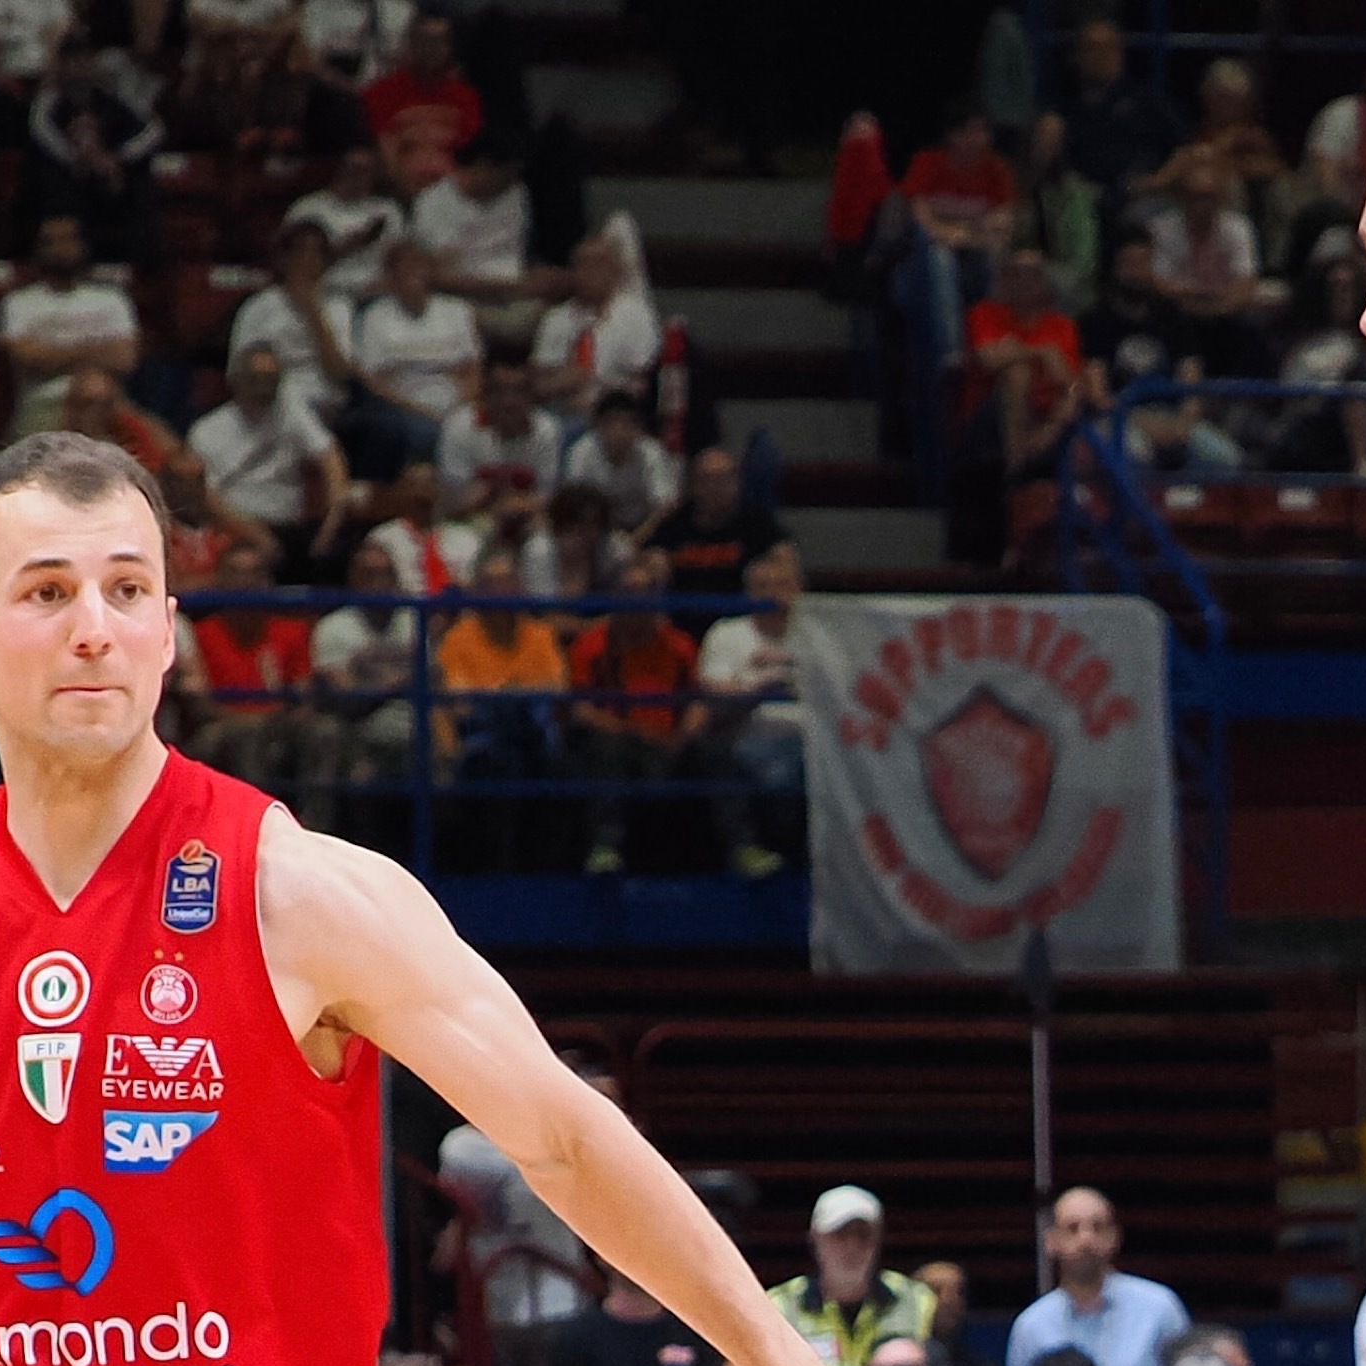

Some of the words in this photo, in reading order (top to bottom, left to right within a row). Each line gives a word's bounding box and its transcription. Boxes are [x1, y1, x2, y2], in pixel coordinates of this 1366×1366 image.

[171, 876, 212, 893] LBA
[36, 1042, 66, 1055] FIP
[101, 1078, 225, 1101] EYEWEAR
[105, 1120, 192, 1162] SAP
